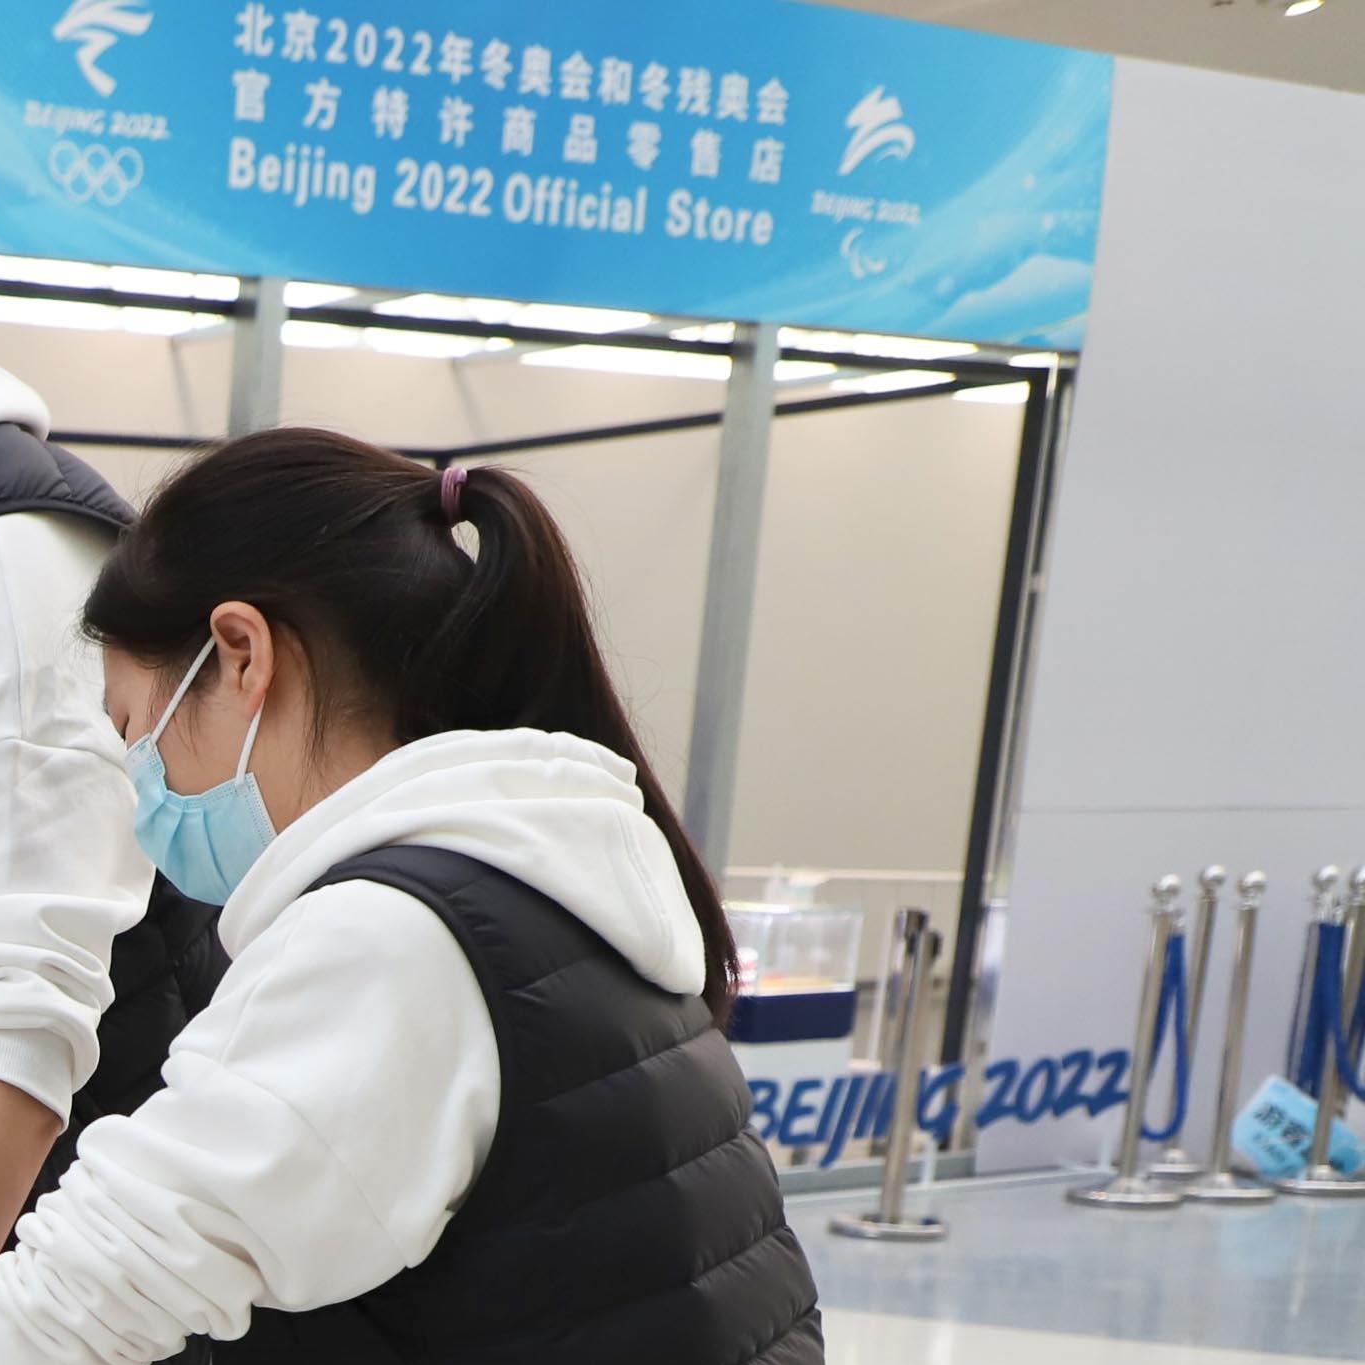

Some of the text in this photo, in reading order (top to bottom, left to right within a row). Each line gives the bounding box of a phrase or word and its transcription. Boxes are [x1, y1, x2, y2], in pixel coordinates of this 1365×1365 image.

[233, 1, 789, 127] 北京2022年冬奥会和冬残奥会
[231, 67, 785, 185] 官方特许商品零售店
[227, 135, 774, 246] Beijing 2022 Official Store
[975, 1047, 1130, 1129] 2022
